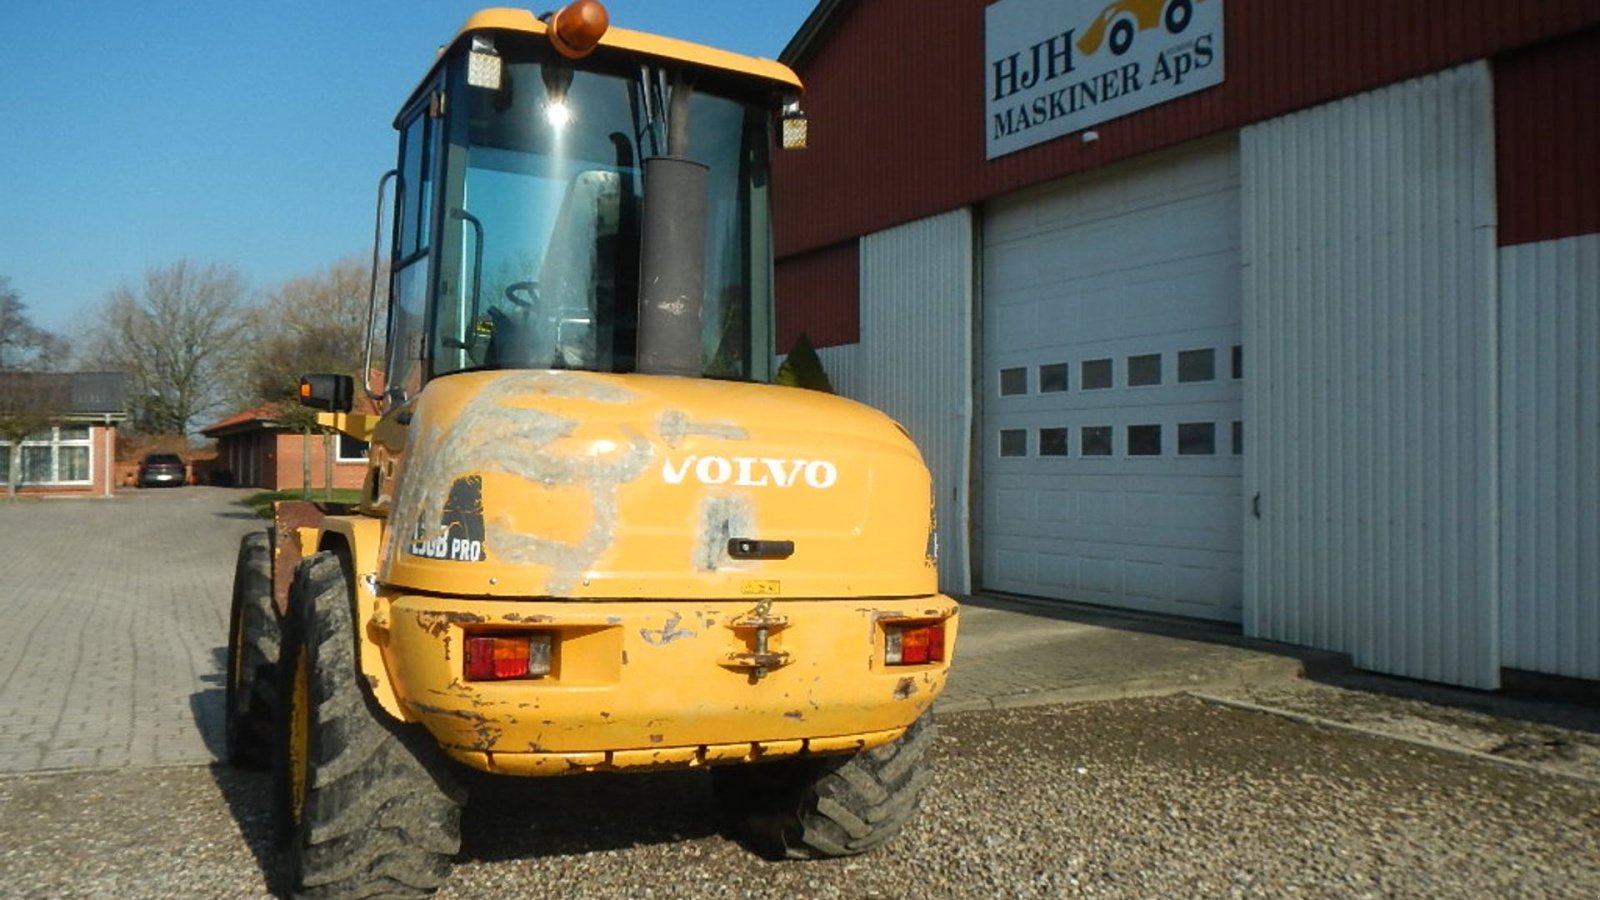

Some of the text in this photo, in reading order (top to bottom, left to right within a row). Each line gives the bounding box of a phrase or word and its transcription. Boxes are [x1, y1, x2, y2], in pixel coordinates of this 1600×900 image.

[992, 28, 1076, 101] HJH
[993, 33, 1214, 140] MASKINER ApS
[662, 455, 837, 489] VOLVO
[451, 537, 481, 562] PRO
